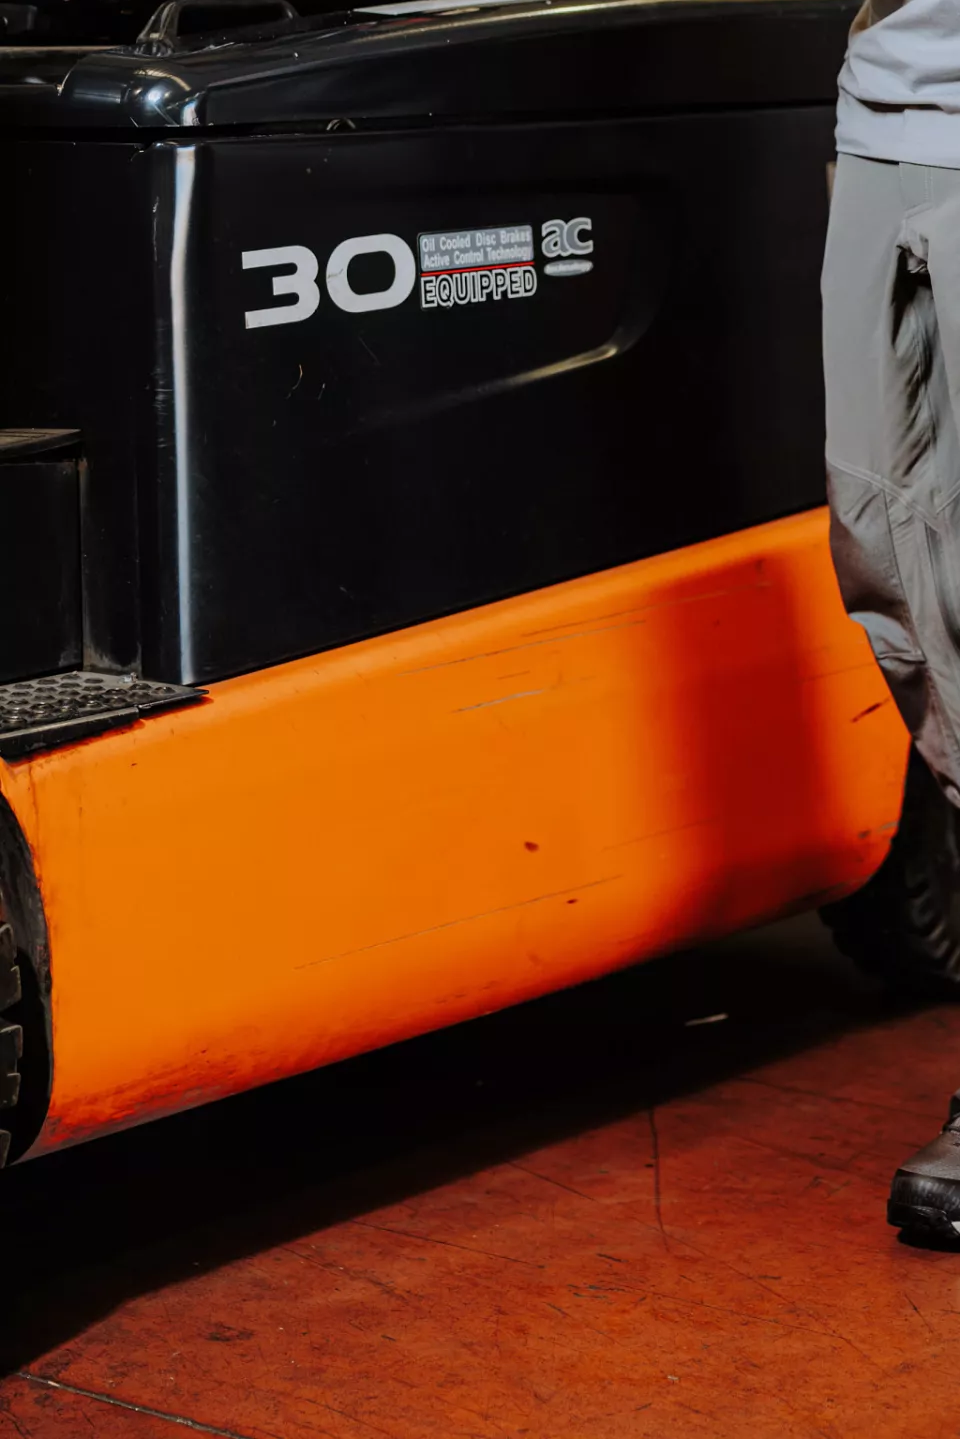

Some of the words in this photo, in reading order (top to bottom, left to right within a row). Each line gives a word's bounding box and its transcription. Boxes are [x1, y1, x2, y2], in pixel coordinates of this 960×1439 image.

[422, 238, 435, 252] Oil
[439, 234, 471, 250] Cooled
[475, 232, 496, 247] Disc
[500, 229, 531, 245] Brakes
[424, 253, 450, 268] Active
[453, 249, 484, 265] Control
[486, 244, 533, 261] Technology
[541, 217, 594, 258] ac
[241, 233, 417, 329] 30
[421, 265, 537, 308] EQUIPPED
